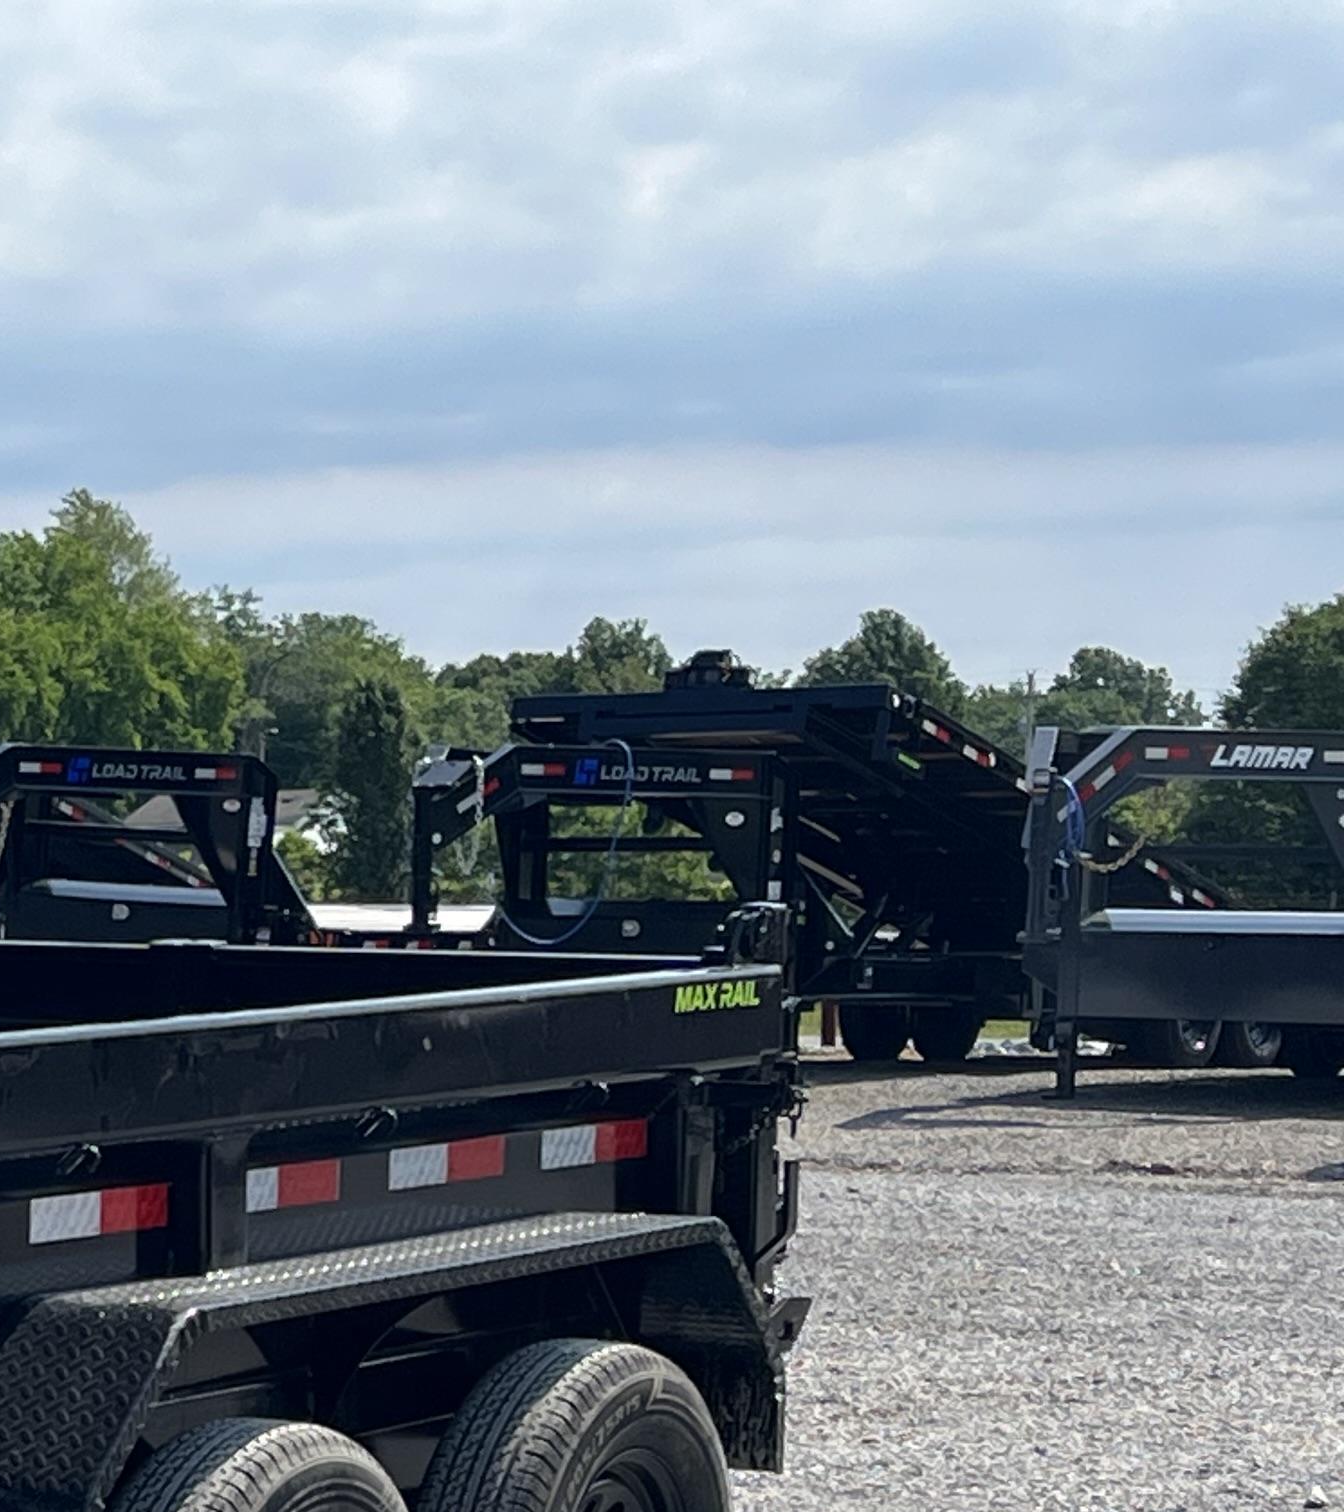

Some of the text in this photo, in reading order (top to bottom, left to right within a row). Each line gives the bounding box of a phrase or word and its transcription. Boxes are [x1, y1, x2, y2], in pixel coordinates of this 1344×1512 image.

[1210, 744, 1315, 770] LAMAR
[92, 763, 188, 781] LOAD TRAIL
[651, 766, 702, 783] TRAIL
[674, 981, 761, 1014] MAX RAIL
